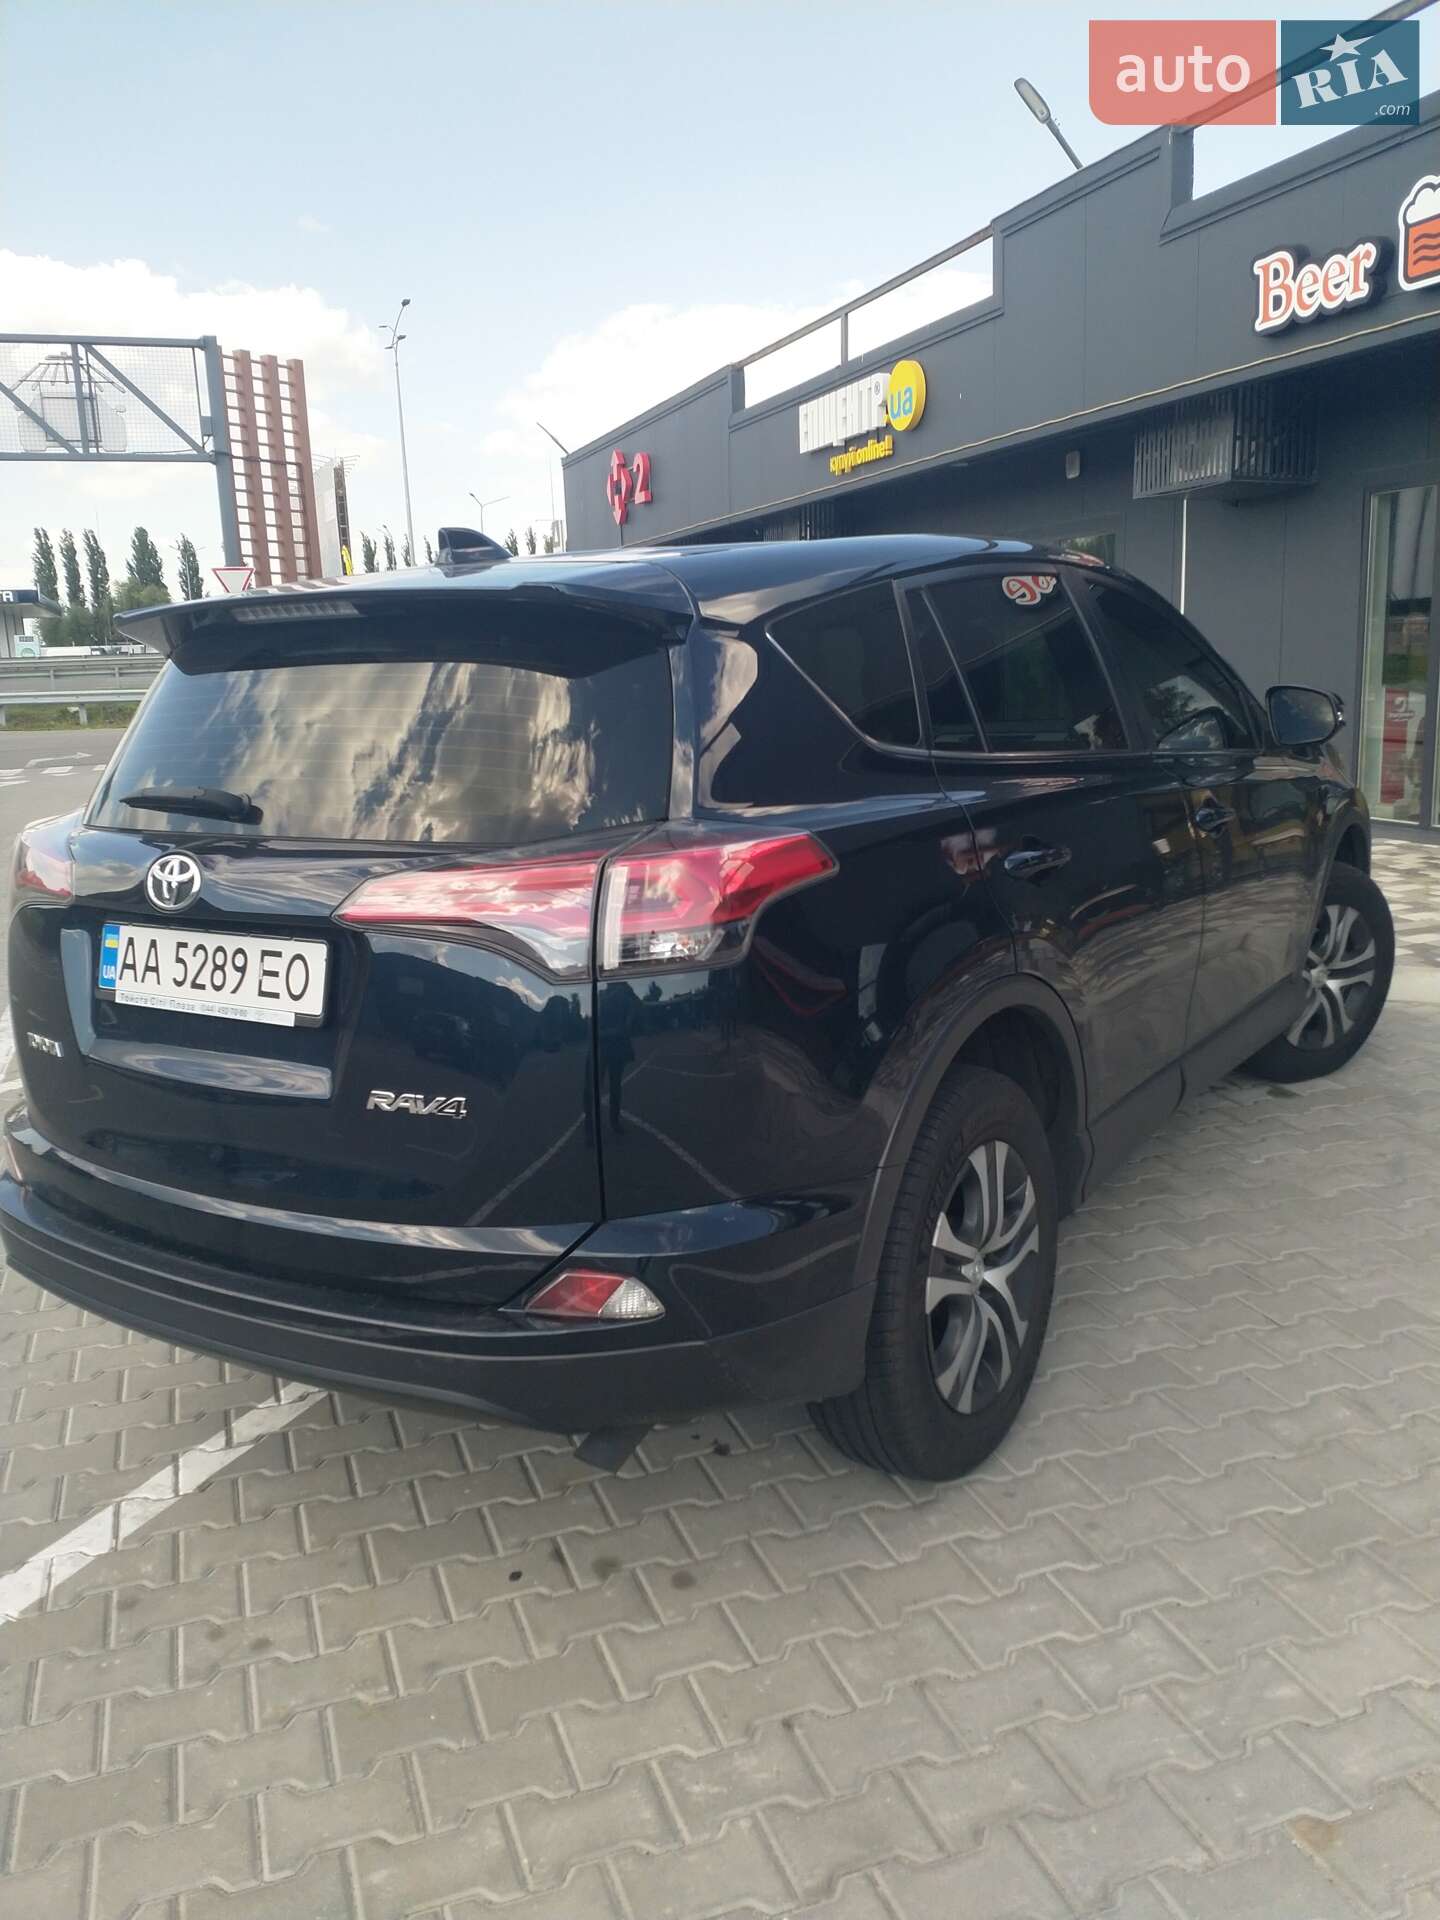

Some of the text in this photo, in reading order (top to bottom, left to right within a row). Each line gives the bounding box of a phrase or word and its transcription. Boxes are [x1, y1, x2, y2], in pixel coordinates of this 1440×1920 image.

[1254, 243, 1376, 332] Beer
[890, 387, 913, 420] ua
[633, 452, 653, 505] 2
[103, 936, 310, 1002] UA AA 5289 EO
[366, 1090, 467, 1119] RAV4
